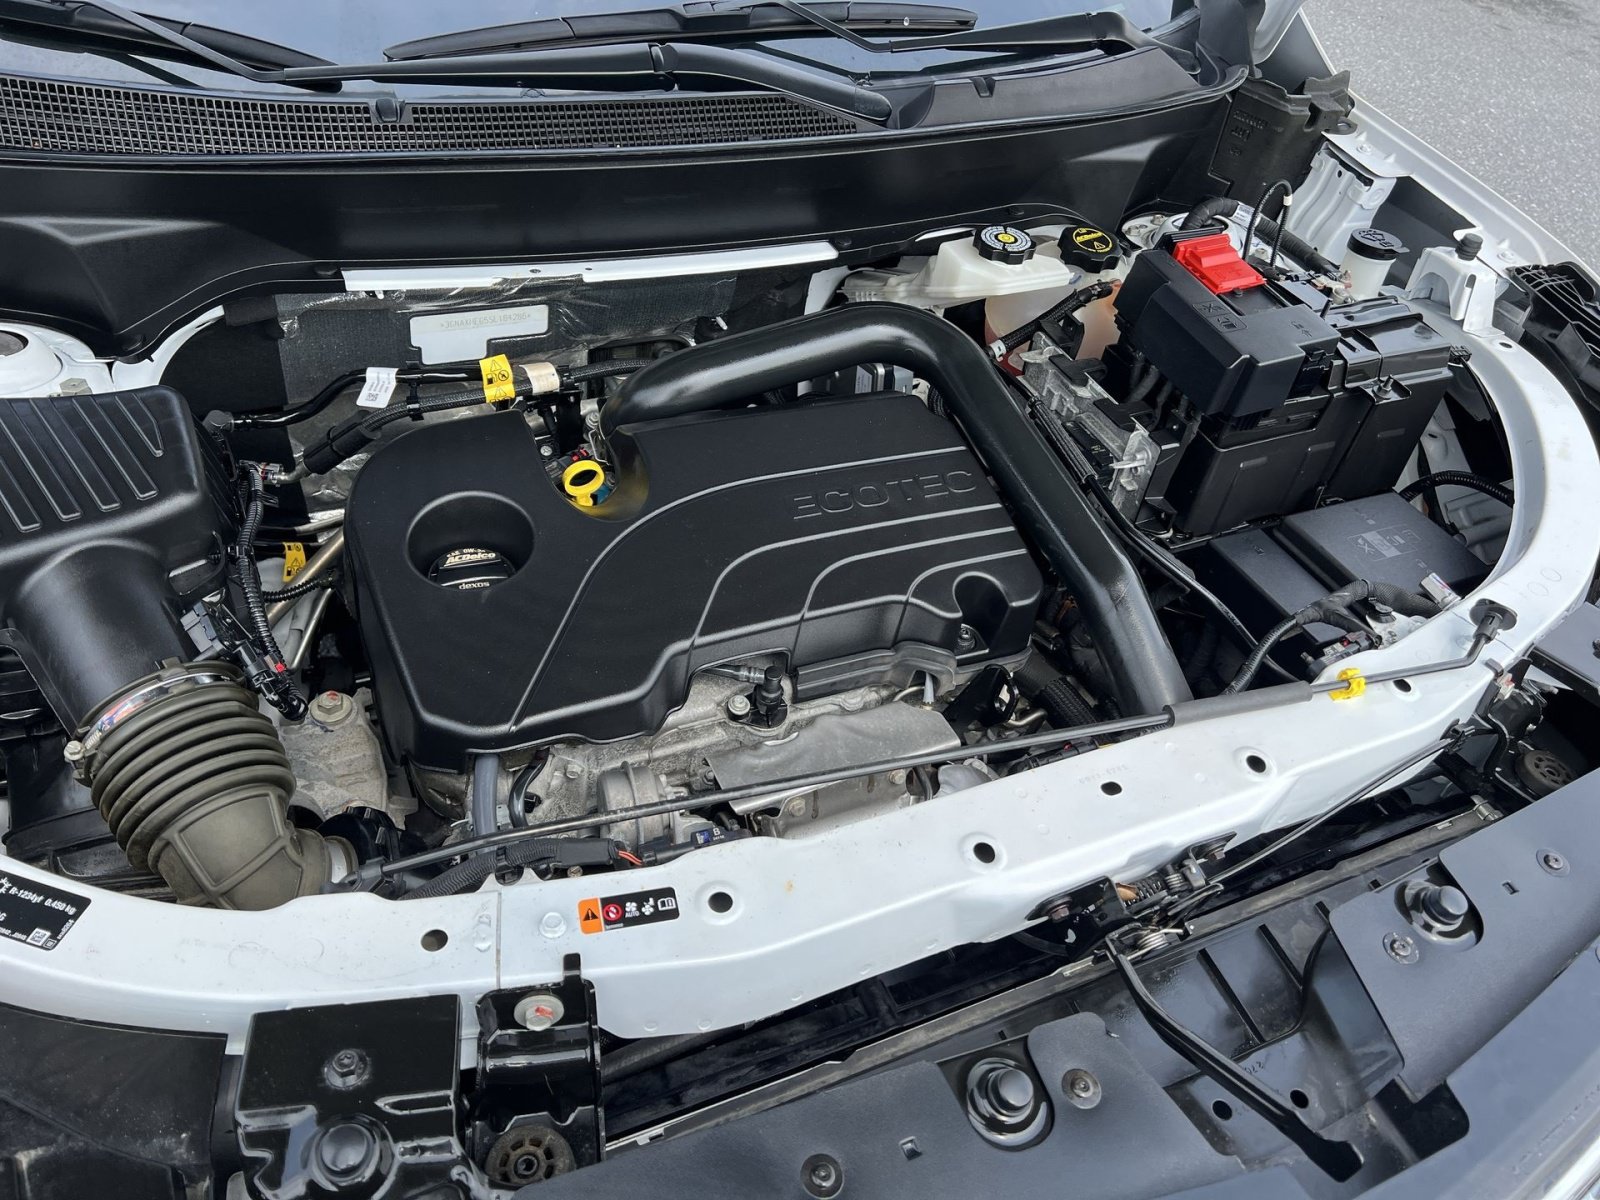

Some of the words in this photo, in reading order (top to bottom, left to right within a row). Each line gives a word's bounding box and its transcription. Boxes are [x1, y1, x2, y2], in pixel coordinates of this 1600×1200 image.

[793, 470, 977, 520] ECOTEC
[445, 552, 496, 565] ACDelco
[458, 581, 490, 590] dexos
[9, 886, 44, 903] R-1234yf
[44, 898, 66, 911] 0.450
[65, 904, 77, 915] kg
[625, 910, 640, 918] AUTO
